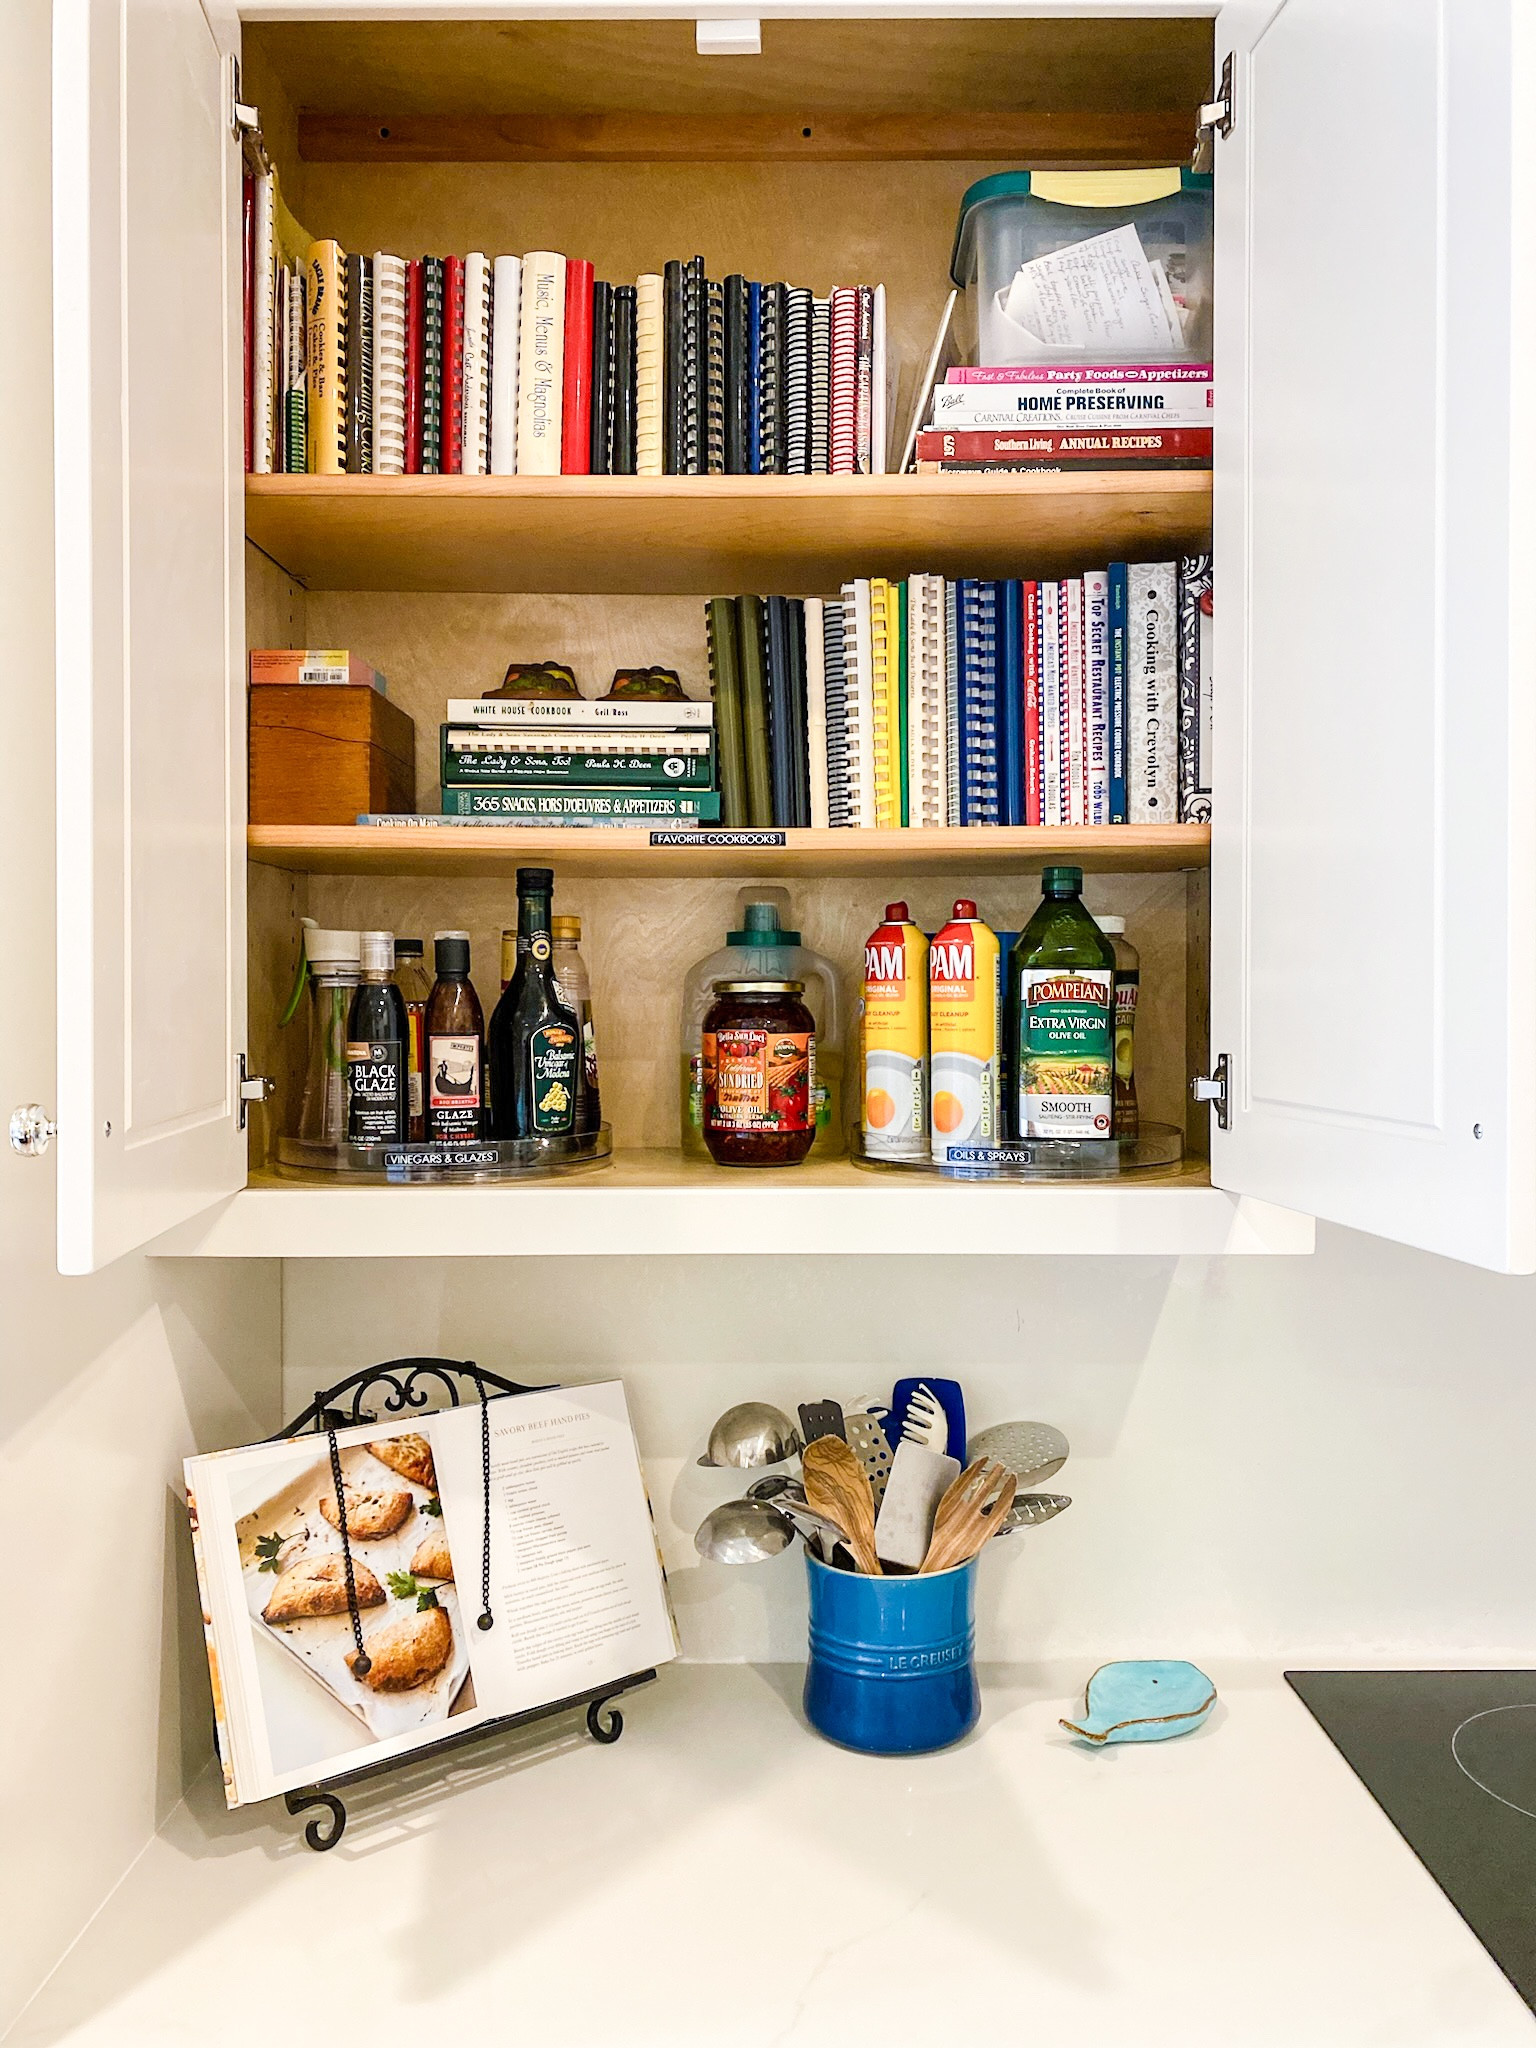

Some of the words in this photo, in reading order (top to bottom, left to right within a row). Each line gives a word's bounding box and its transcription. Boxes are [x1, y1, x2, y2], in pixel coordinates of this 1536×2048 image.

[312, 259, 324, 284] EAGLE
[312, 286, 324, 316] BRAND
[535, 274, 554, 310] Music,
[318, 323, 326, 362] Cookies
[535, 316, 554, 356] Menus
[312, 356, 318, 364] &
[318, 364, 326, 373] &
[534, 360, 552, 374] &
[972, 370, 995, 381] Fast
[1005, 370, 1044, 381] Fabulous
[1047, 369, 1083, 382] Party
[1085, 369, 1124, 380] Foods
[1138, 368, 1208, 381] Appetizers
[318, 377, 326, 398] Bars
[527, 379, 552, 438] Magnolias
[941, 394, 964, 409] Ball
[1018, 396, 1062, 410] HOME
[1066, 395, 1164, 410] PRESERVING
[974, 412, 1014, 423] CARNIVAL
[1130, 412, 1160, 420] CARNIVAL
[943, 434, 955, 456] 1979
[994, 438, 1028, 450] Southern
[1030, 438, 1053, 452] Living
[1060, 437, 1110, 449] ANNUAL
[1112, 436, 1162, 448] RECIPES
[1091, 598, 1105, 617] TOP
[1091, 621, 1105, 655] SECRET
[1114, 628, 1122, 638] THE
[1143, 609, 1159, 674] Cooking
[1114, 639, 1122, 661] INSTANT
[1070, 665, 1079, 686] WANTED
[1114, 663, 1122, 674] POT
[1048, 684, 1056, 705] WANTED
[1091, 660, 1106, 718] RESTAURANT
[1114, 676, 1122, 700] ELECTRIC
[1147, 678, 1159, 712] with
[1070, 688, 1079, 709] RECIPES
[473, 706, 496, 715] WHITE
[501, 706, 525, 715] HOUSE
[531, 706, 571, 716] COOKBOOK
[1048, 707, 1057, 728] RECIPES
[1114, 701, 1122, 728] PRESSURE
[1091, 724, 1106, 761] RECIPES
[1114, 729, 1122, 749] COOKER
[458, 755, 477, 765] The
[481, 755, 506, 769] Lady
[510, 756, 521, 765] &
[525, 756, 548, 766] Sons,
[552, 755, 571, 766] Too!
[1072, 750, 1081, 762] RON
[1142, 718, 1160, 788] Crevolyn
[584, 758, 610, 769] Paula
[612, 759, 626, 768] H.
[629, 759, 652, 768] Deen
[1114, 750, 1122, 778] COOKBOOK
[1049, 773, 1057, 783] RON
[1072, 763, 1081, 788] DOUGLAS
[1049, 784, 1058, 810] DOUGLAS
[1094, 781, 1103, 800] TODD
[473, 796, 500, 811] 365
[502, 797, 536, 813] SNACKS,
[538, 798, 562, 812] HORS
[564, 798, 611, 814] D'OEUVRES
[613, 800, 622, 813] &
[623, 800, 675, 814] APPETIZERS
[1093, 803, 1103, 824] WILBU
[418, 818, 438, 827] Main
[658, 834, 706, 844] FAVORITE
[707, 834, 776, 844] COOKBOOKS
[865, 946, 903, 980] PAM
[931, 945, 972, 980] PAM
[865, 985, 898, 993] RIGINAL
[1033, 983, 1104, 1001] POMPEIAN
[1029, 1016, 1066, 1029] EXTRA
[1068, 1016, 1107, 1029] VIRGIN
[734, 1031, 749, 1041] Sun
[355, 1064, 396, 1078] BLACK
[535, 1056, 565, 1068] Vinegar
[536, 1068, 570, 1079] Modena
[355, 1079, 396, 1091] GLAZE
[436, 1110, 473, 1120] GLAZE
[748, 1105, 762, 1113] OIL
[1041, 1101, 1091, 1112] SMOOTH
[390, 1155, 442, 1164] VINEGARS
[444, 1154, 452, 1163] &
[455, 1152, 494, 1162] GLAZES
[953, 1150, 976, 1160] OILS
[978, 1152, 985, 1161] &
[987, 1151, 1025, 1162] SPRAYS
[494, 1424, 526, 1437] SAVORY
[528, 1420, 550, 1431] BEEF
[551, 1415, 574, 1426] HAND
[574, 1412, 590, 1421] PIES
[890, 1657, 907, 1669] LE
[910, 1642, 964, 1668] CREUSET
